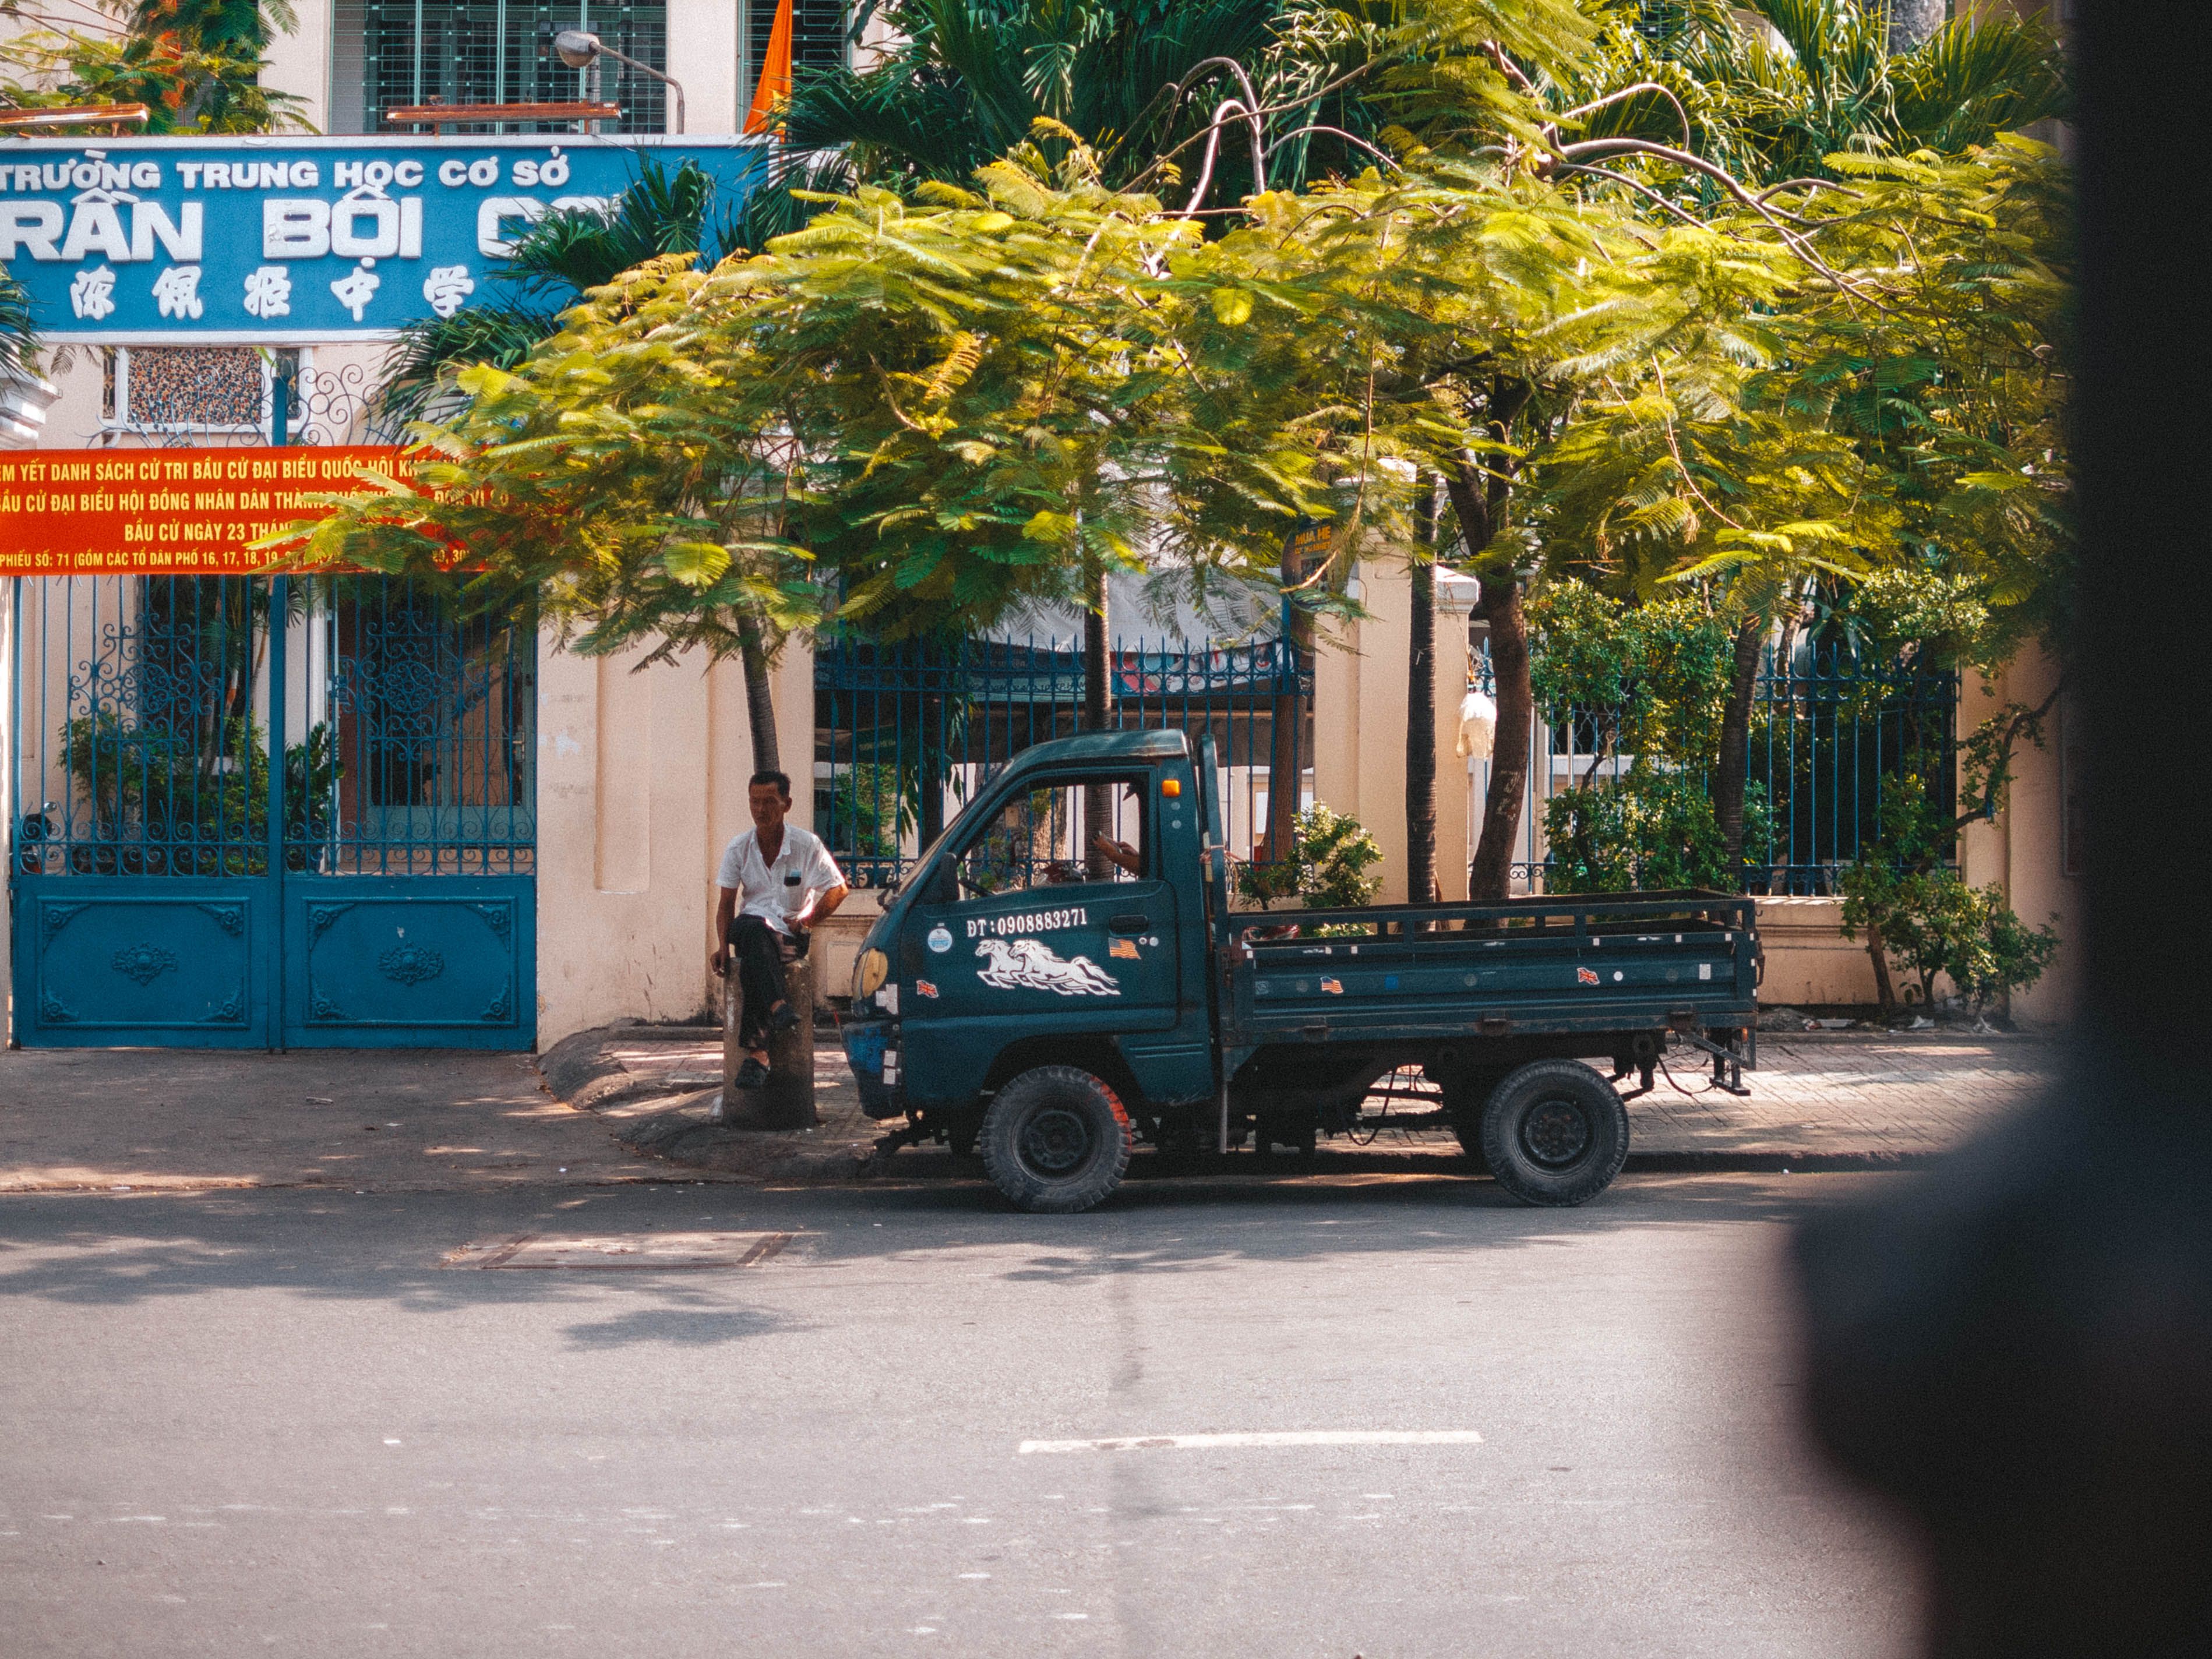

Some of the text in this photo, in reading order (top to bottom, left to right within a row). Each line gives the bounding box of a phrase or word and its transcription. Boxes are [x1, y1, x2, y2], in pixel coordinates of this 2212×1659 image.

[177, 161, 319, 188] TRUNG
[334, 161, 423, 193] HỌC
[439, 156, 498, 187] CƠ
[512, 146, 569, 187] SỞ
[263, 185, 422, 269] BỘI
[20, 458, 46, 481] YẾT
[51, 463, 90, 481] DANH
[96, 459, 134, 481] SÁCH
[139, 457, 160, 480] CỬ
[164, 462, 188, 480] TRI
[193, 456, 223, 479] BẦU
[227, 456, 249, 479] CỬ
[252, 461, 277, 483] ĐẠI
[283, 453, 316, 478] BIỂU
[26, 489, 47, 512] CỬ
[50, 494, 75, 516] ĐẠI
[80, 486, 114, 511] BIỂU
[119, 489, 144, 515] HỘI
[149, 486, 189, 511] ĐỒNG
[195, 488, 235, 510] NHÂN
[240, 488, 269, 510] DÂN
[125, 518, 153, 541] BẦU
[158, 518, 179, 541] CỬ
[184, 519, 222, 541] NGÀY
[227, 523, 245, 541] 23
[0, 549, 31, 567] PHIẾU
[35, 549, 53, 567] SỐ:
[57, 553, 69, 566] 71
[74, 548, 103, 569] (GỒM
[107, 550, 128, 566] CÁC
[132, 546, 146, 566] TỔ
[150, 549, 171, 565] DÂN
[175, 548, 199, 565] PHỐ
[203, 552, 219, 567] 16,
[223, 552, 239, 567] 17,
[244, 551, 260, 566] 18,
